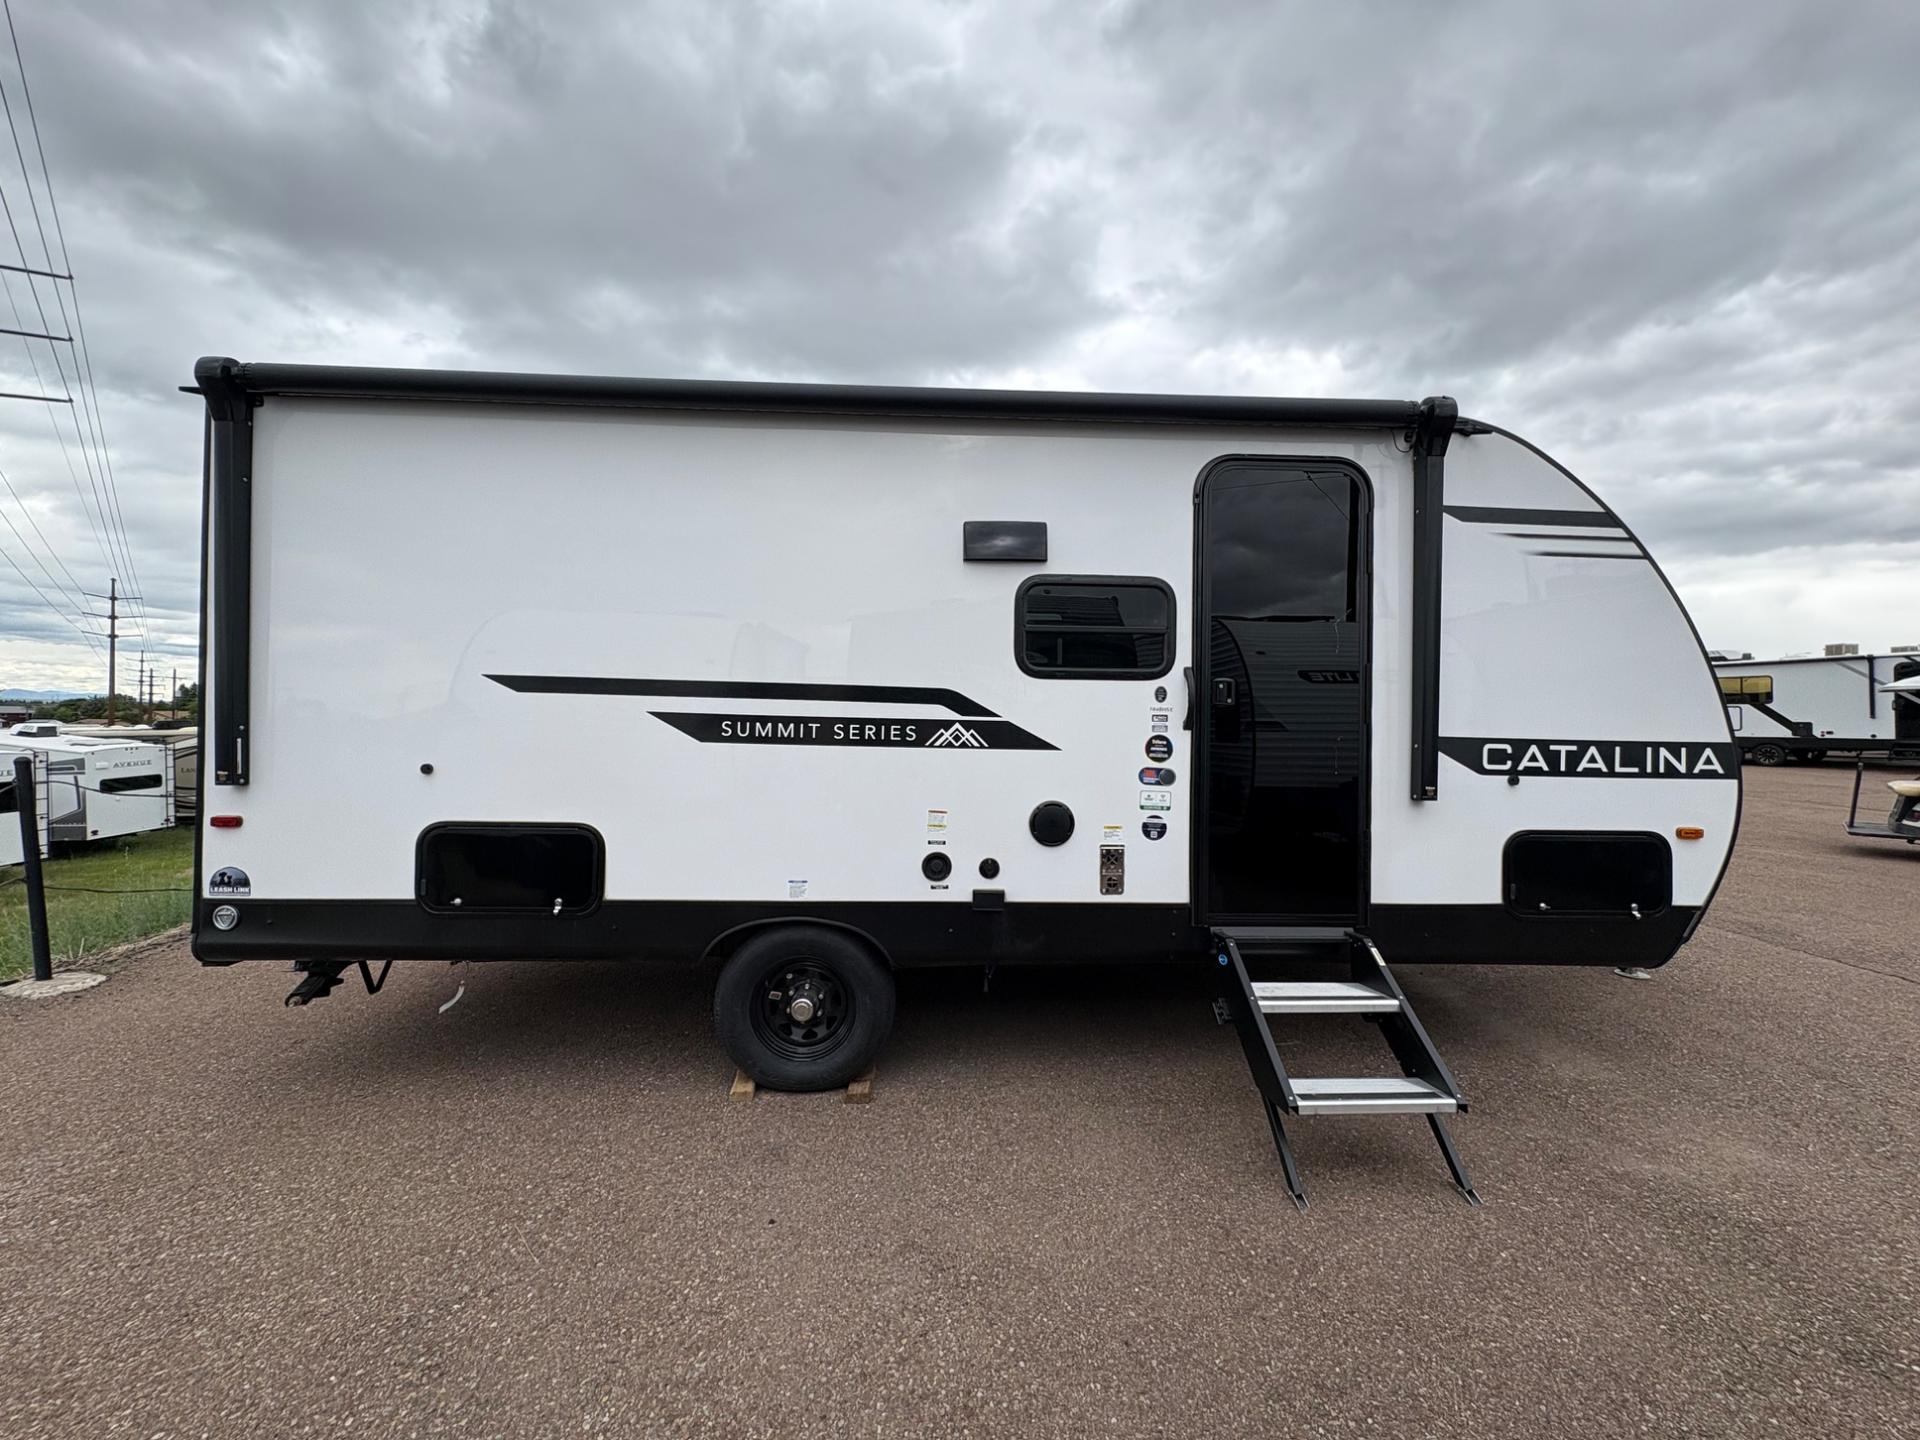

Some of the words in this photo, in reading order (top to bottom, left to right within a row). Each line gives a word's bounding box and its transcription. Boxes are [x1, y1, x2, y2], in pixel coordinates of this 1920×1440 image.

[721, 720, 821, 738] SUMMIT
[833, 723, 917, 741] SERIES
[112, 759, 152, 768] AVENUE
[1482, 743, 1725, 774] CATALINA
